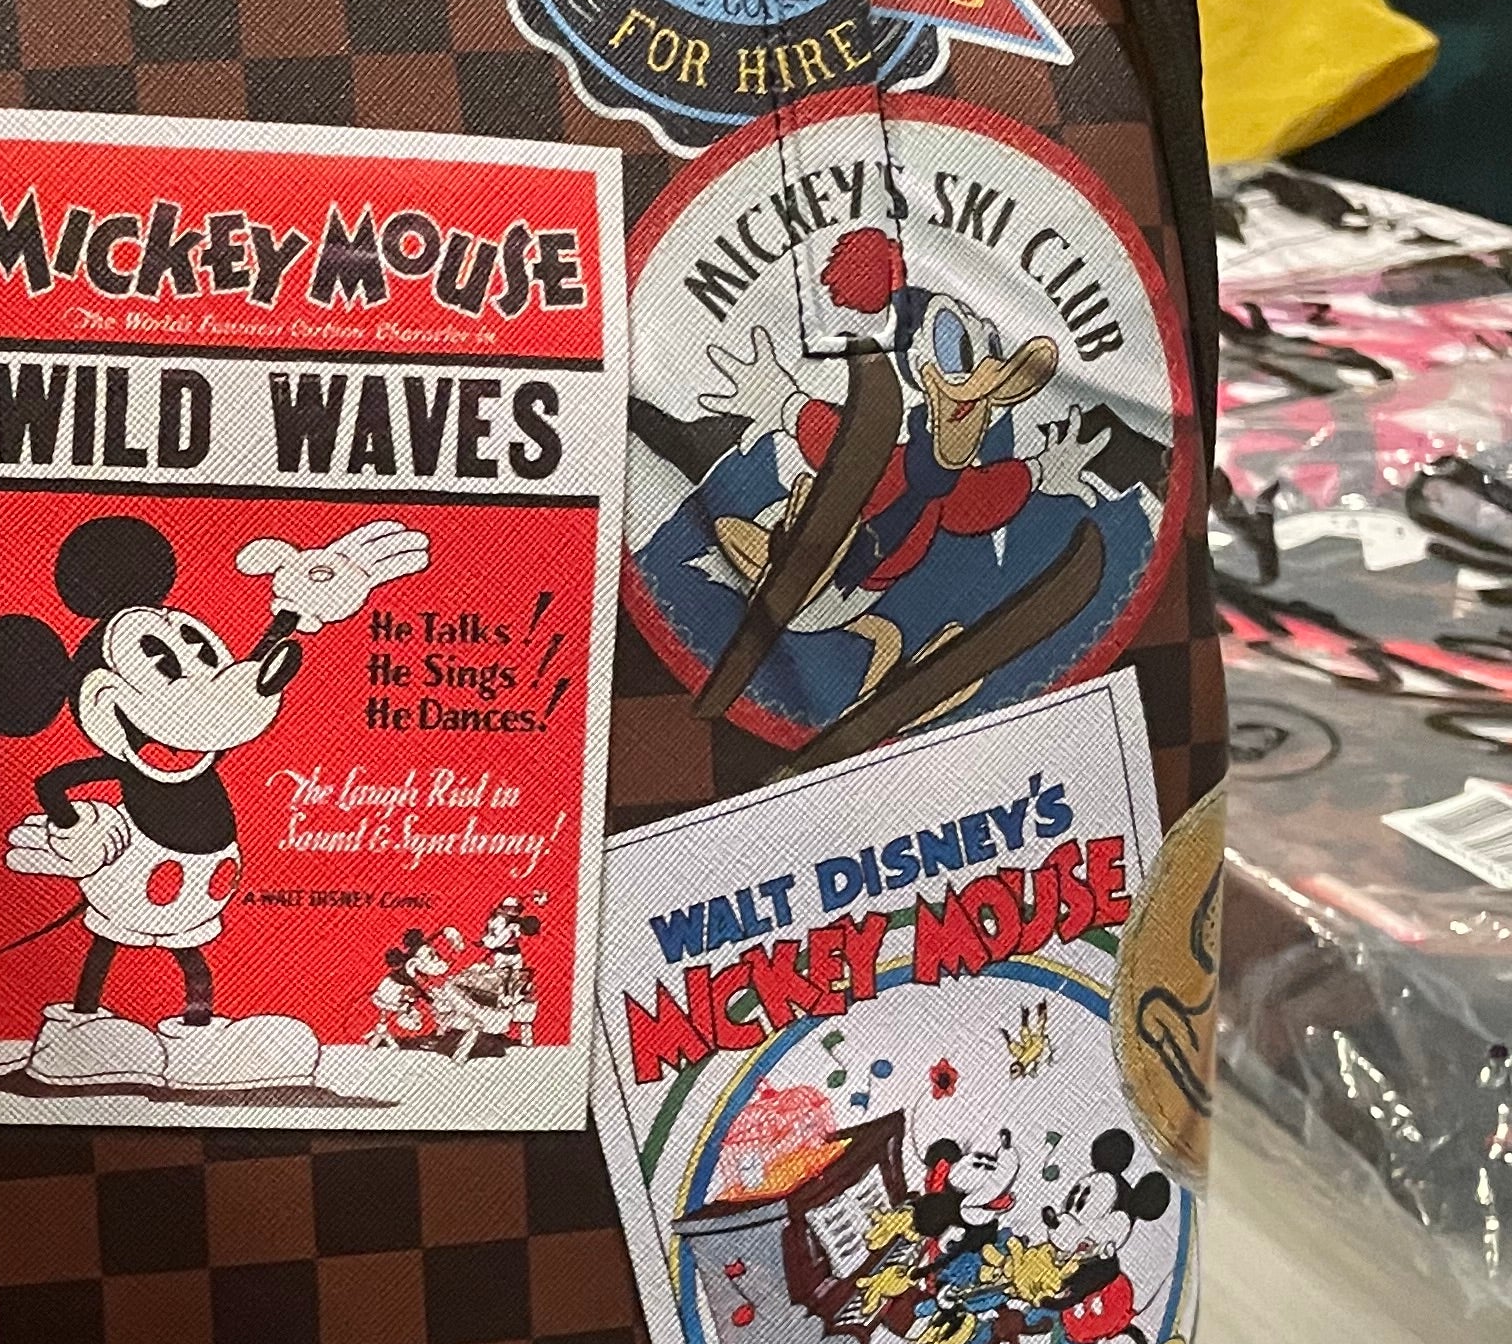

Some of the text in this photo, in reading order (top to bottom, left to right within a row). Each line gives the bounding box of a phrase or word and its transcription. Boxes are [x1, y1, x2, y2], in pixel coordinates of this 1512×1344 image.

[608, 8, 874, 96] FOR HIRE
[305, 199, 589, 322] MOUSE
[683, 158, 1126, 362] MICKEY'S SKI CLUB
[270, 371, 560, 480] WAVES
[369, 609, 413, 645] He
[367, 653, 411, 687] He
[364, 697, 410, 732] He
[265, 764, 521, 820] The Laugh Riot in
[277, 806, 369, 853] Sound
[369, 824, 391, 853] &
[241, 891, 256, 906] A
[308, 889, 373, 909] DISNEY
[649, 770, 1076, 964] WALT DISNEY'S
[621, 834, 1134, 1087] MICKEY MOUSE
